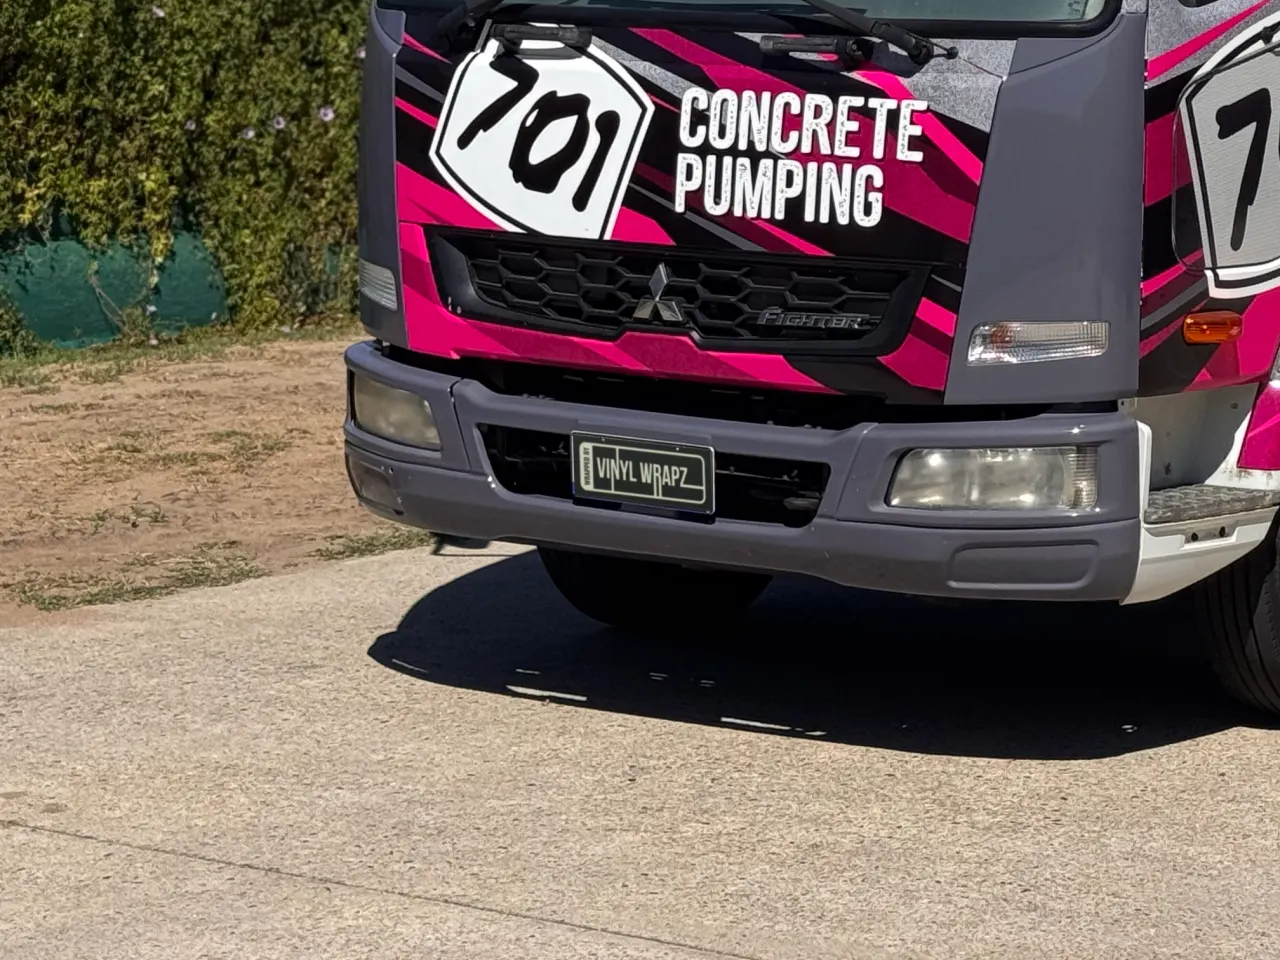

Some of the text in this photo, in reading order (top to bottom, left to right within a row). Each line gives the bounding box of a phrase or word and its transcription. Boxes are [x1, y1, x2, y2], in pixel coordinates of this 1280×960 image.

[456, 54, 621, 213] 701
[678, 87, 929, 162] CONCRETE
[674, 152, 884, 228] PUMPING
[583, 456, 591, 486] WRAPPED
[596, 455, 688, 490] VINYL WRAPZ
